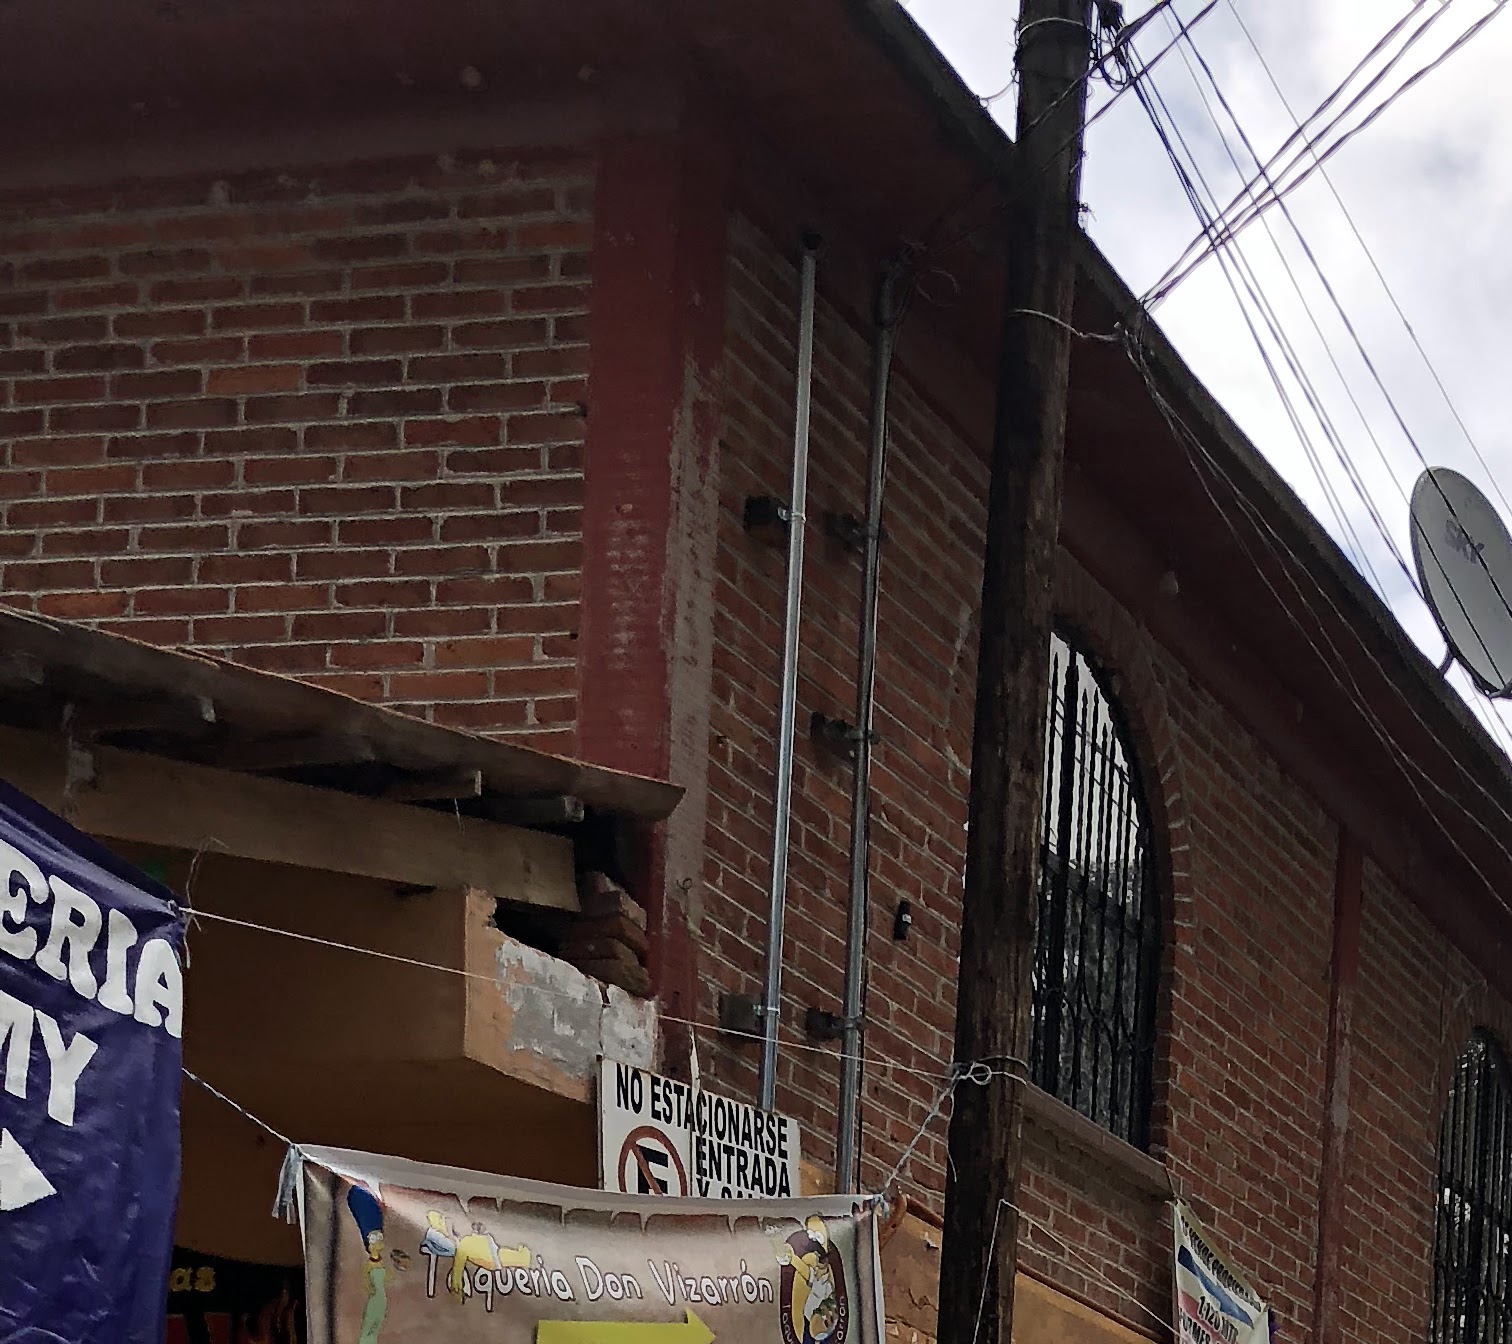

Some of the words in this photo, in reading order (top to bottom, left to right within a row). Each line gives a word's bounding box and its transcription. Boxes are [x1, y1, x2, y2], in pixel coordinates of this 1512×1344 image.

[616, 1062, 643, 1114] NO
[650, 1075, 789, 1160] ESTACIONARSE
[695, 1135, 791, 1198] ENTRADA
[575, 1255, 643, 1302] Don
[647, 1257, 774, 1306] Vizarrón
